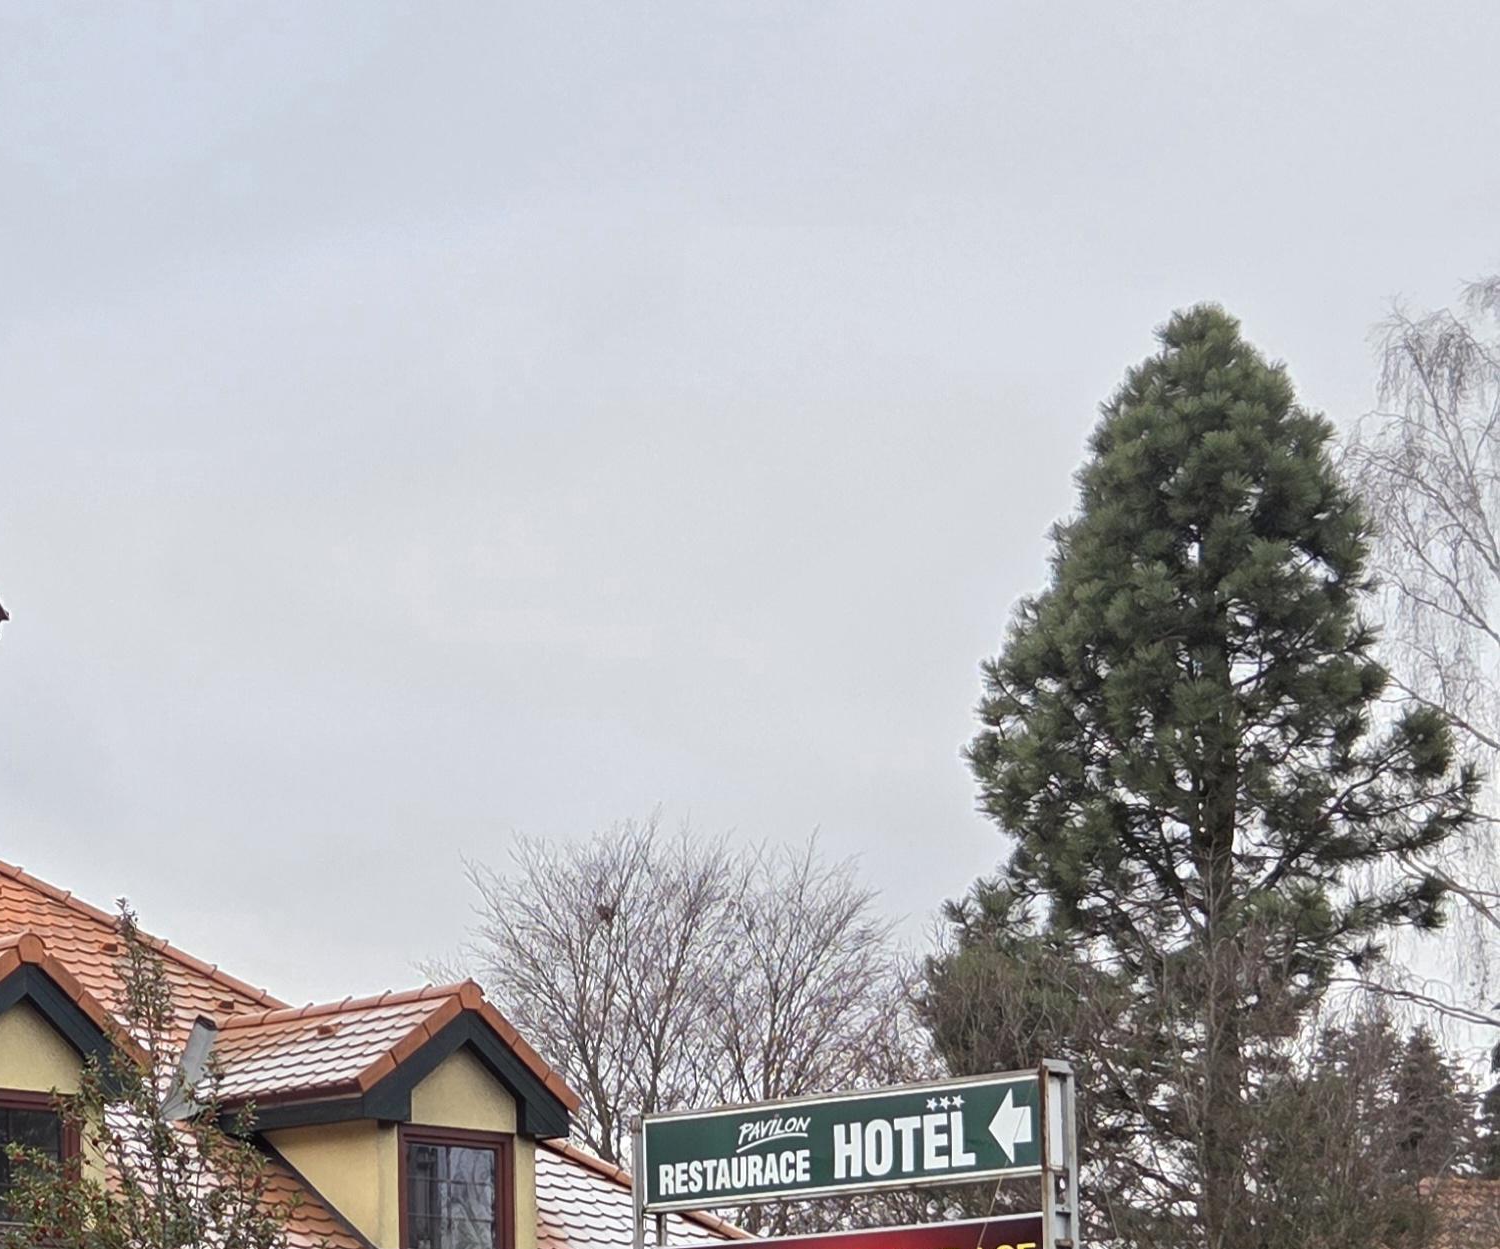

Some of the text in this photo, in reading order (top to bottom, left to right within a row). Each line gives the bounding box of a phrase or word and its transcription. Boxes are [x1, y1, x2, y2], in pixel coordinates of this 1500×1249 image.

[739, 1115, 811, 1145] PAVILON
[833, 1111, 976, 1179] HOTEL
[659, 1150, 810, 1196] RESTAURACE
